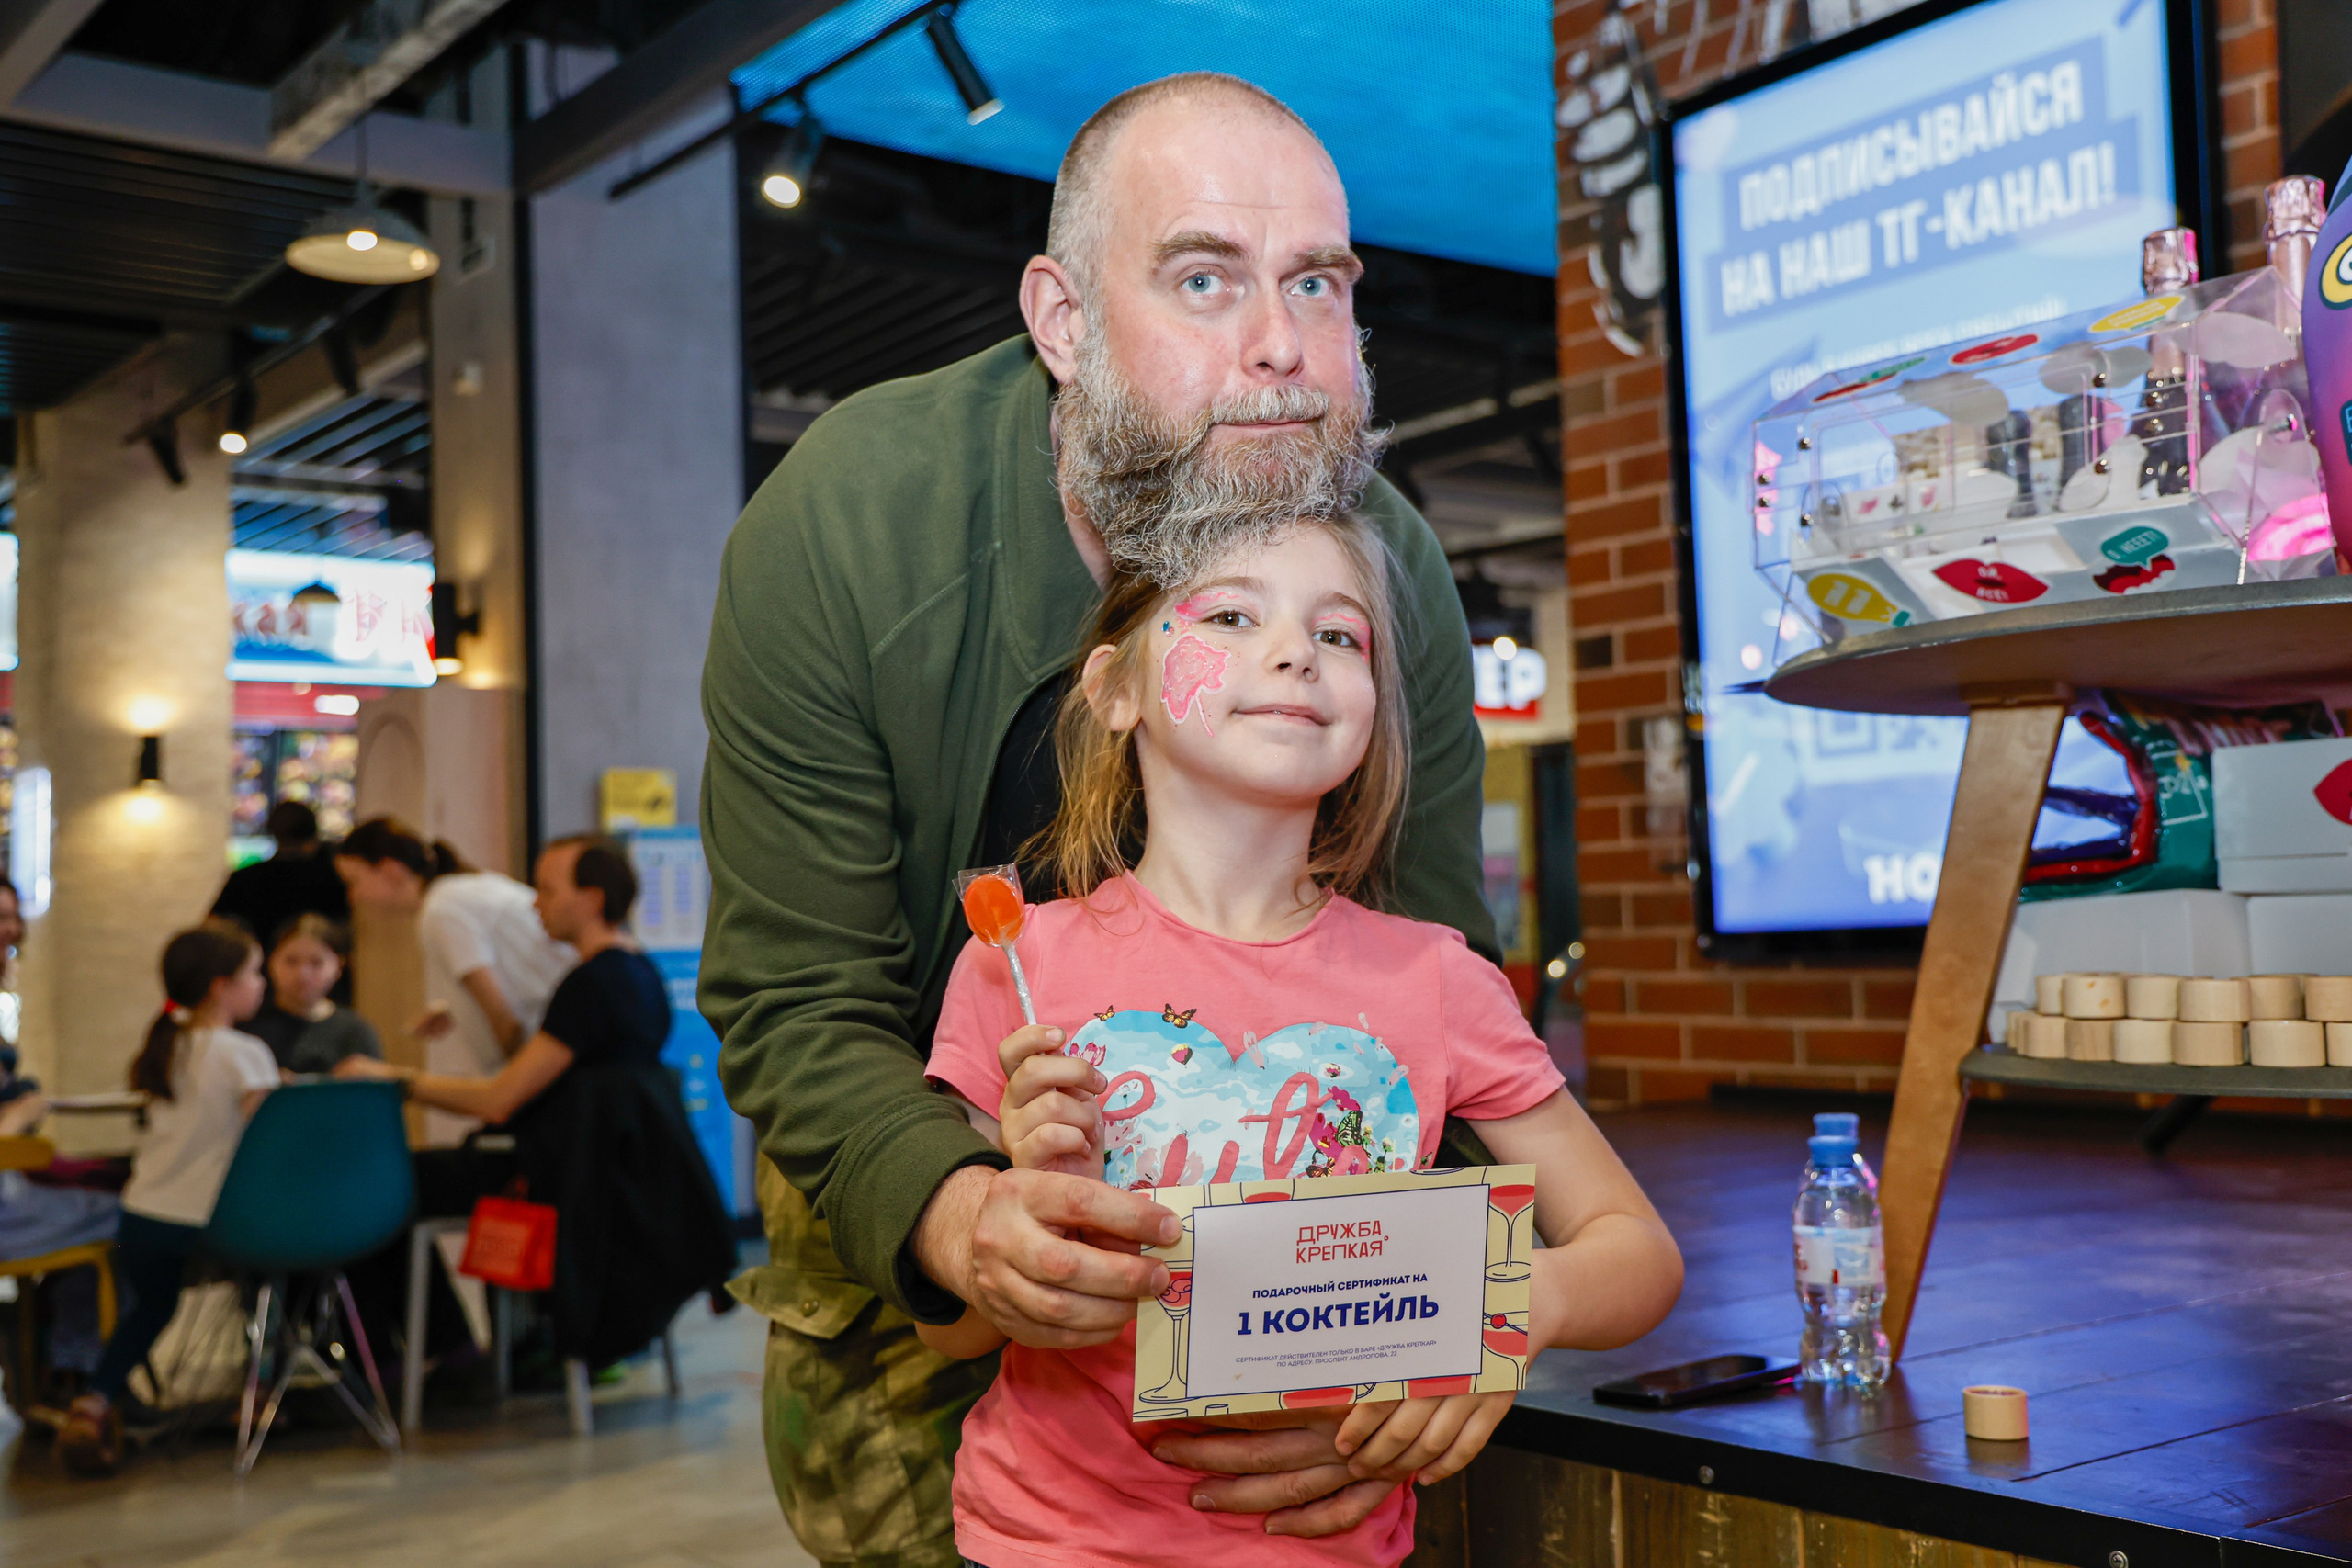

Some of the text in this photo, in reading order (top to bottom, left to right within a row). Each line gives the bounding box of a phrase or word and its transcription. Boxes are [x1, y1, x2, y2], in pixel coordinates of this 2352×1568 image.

[1739, 59, 2084, 231] ПОДПИСЫВАЙСЯ
[1720, 140, 2116, 317] НА НАШ ТГ-КАНАЛ!
[1296, 1220, 1382, 1246] ДРУЖБА
[1252, 1273, 1428, 1299] ПОДАРОЧНЫЙ СЕРТИФИКАТ НА
[1238, 1292, 1440, 1336] 1 КОКТЕЙЛЬ
[1236, 1355, 1278, 1363] СЕРТИФИКАТ
[1279, 1350, 1328, 1360] ДЕЙСТВИТЕЛЕН
[1329, 1348, 1353, 1356] ТОЛЬКО
[1315, 1354, 1348, 1364] ПРОСПЕКТ
